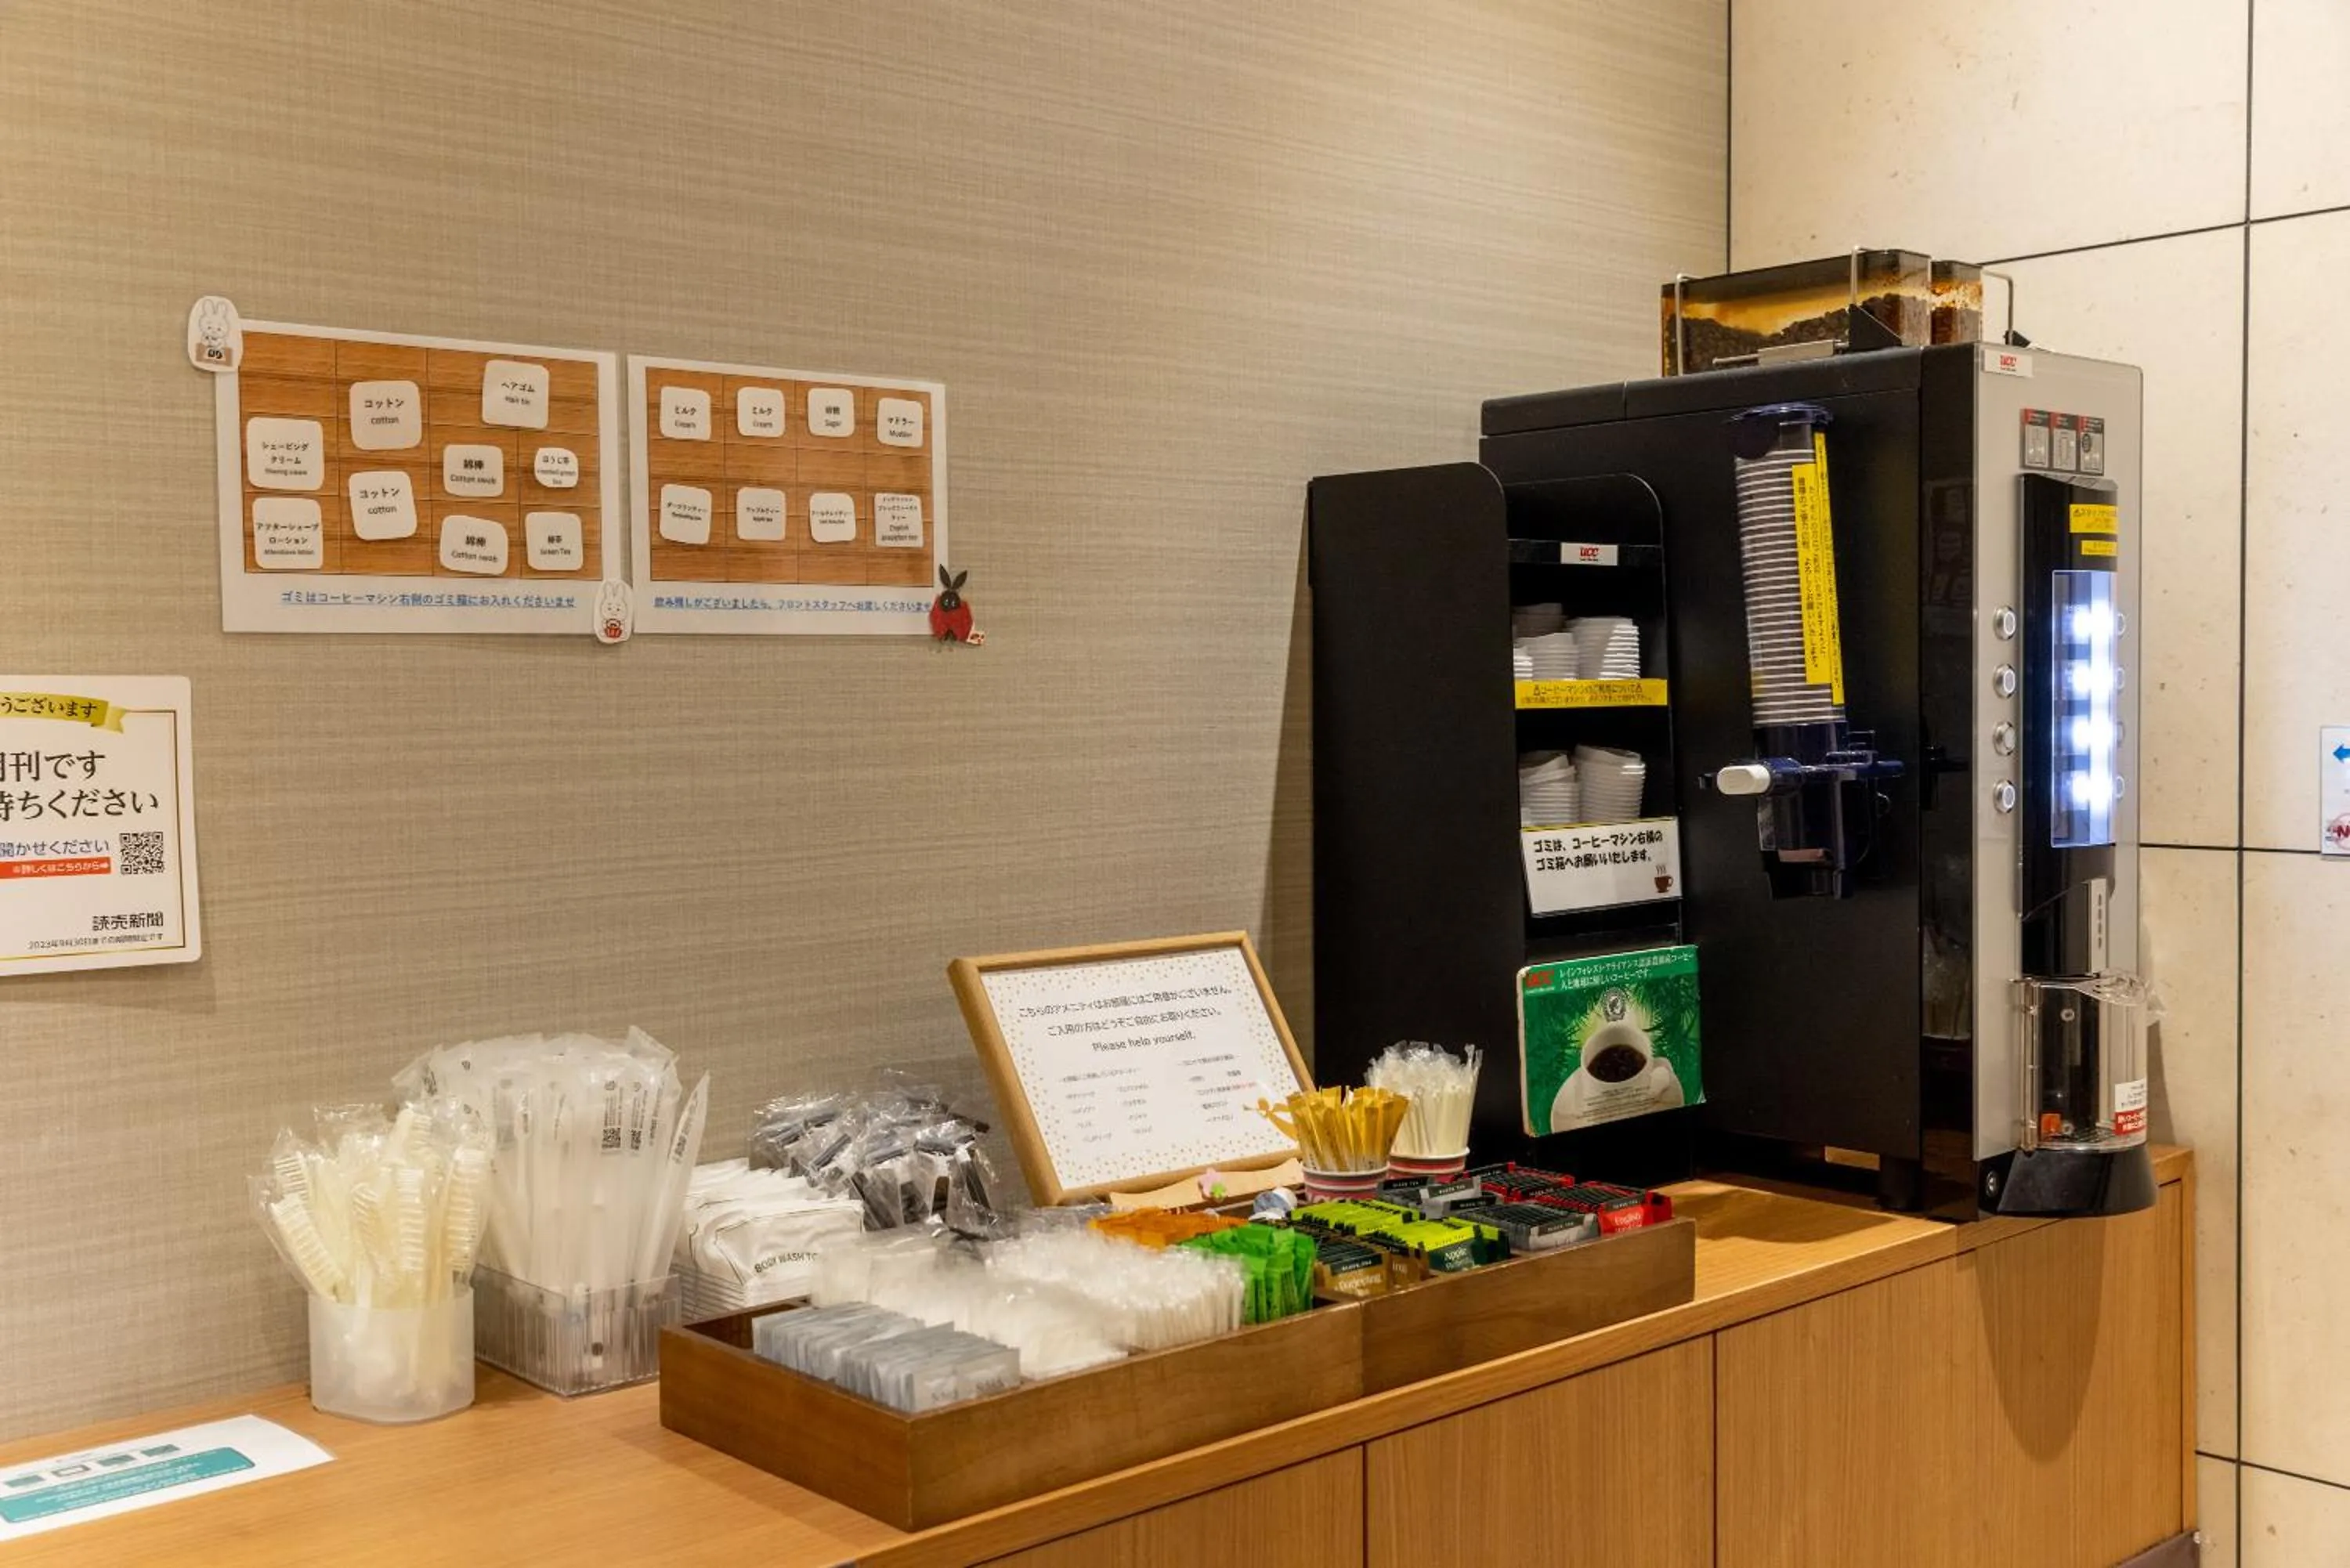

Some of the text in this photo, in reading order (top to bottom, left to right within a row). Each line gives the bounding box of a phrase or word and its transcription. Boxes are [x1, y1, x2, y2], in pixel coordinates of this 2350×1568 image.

[501, 381, 536, 393] ヘアゴム
[363, 397, 405, 410] コットン
[674, 406, 697, 416] ミルク
[752, 406, 773, 416] ミルク
[370, 415, 400, 425] cotton
[262, 441, 310, 452] シェービング
[270, 456, 302, 464] クリーム
[358, 487, 400, 500] コットン
[367, 504, 397, 515] cotton
[269, 537, 308, 545] ローション
[1, 696, 96, 717] うございます
[0, 750, 106, 782] 刊です
[92, 912, 164, 931] 読売新聞
[1092, 1041, 1126, 1051] Please
[1128, 1036, 1151, 1047] help
[754, 1257, 776, 1274] BODY
[778, 1252, 804, 1263] WASH
